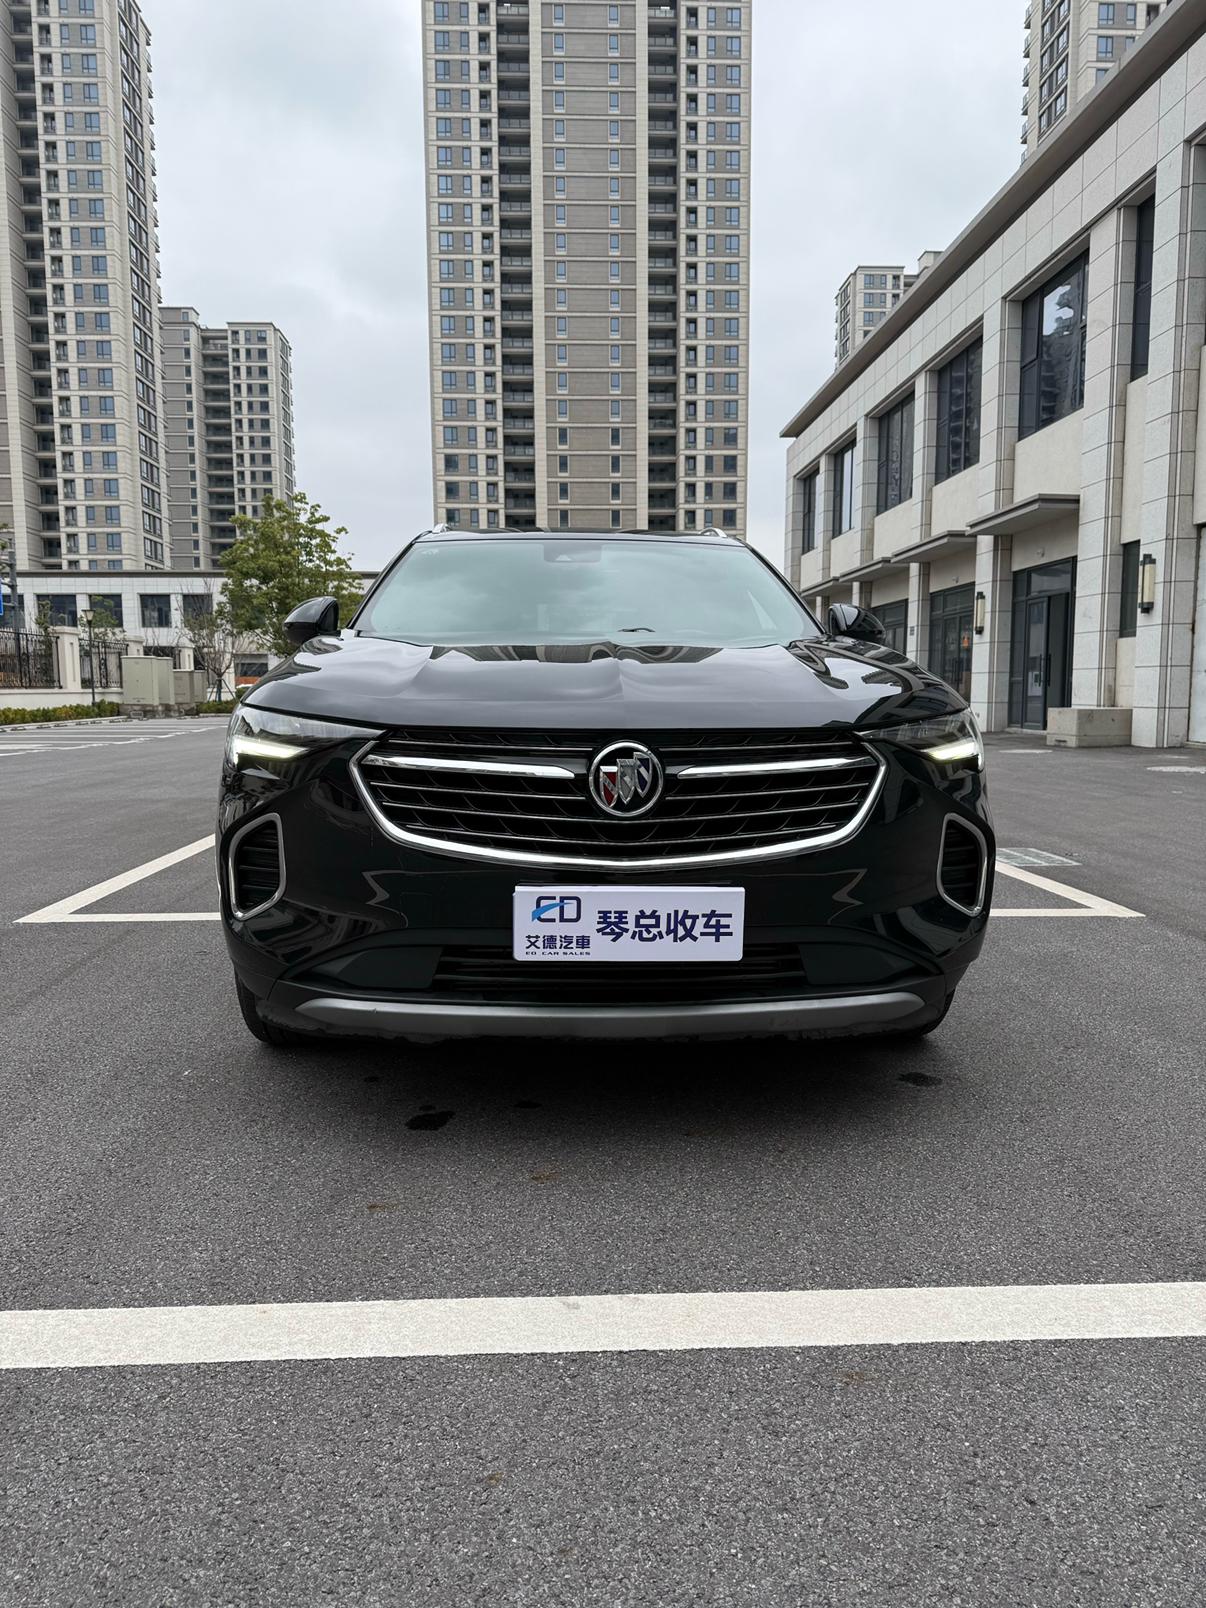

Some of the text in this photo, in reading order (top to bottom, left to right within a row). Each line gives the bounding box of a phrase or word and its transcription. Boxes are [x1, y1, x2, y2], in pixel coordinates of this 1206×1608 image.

[595, 909, 734, 943] 琴总收车
[525, 934, 591, 949] 艾德汽車
